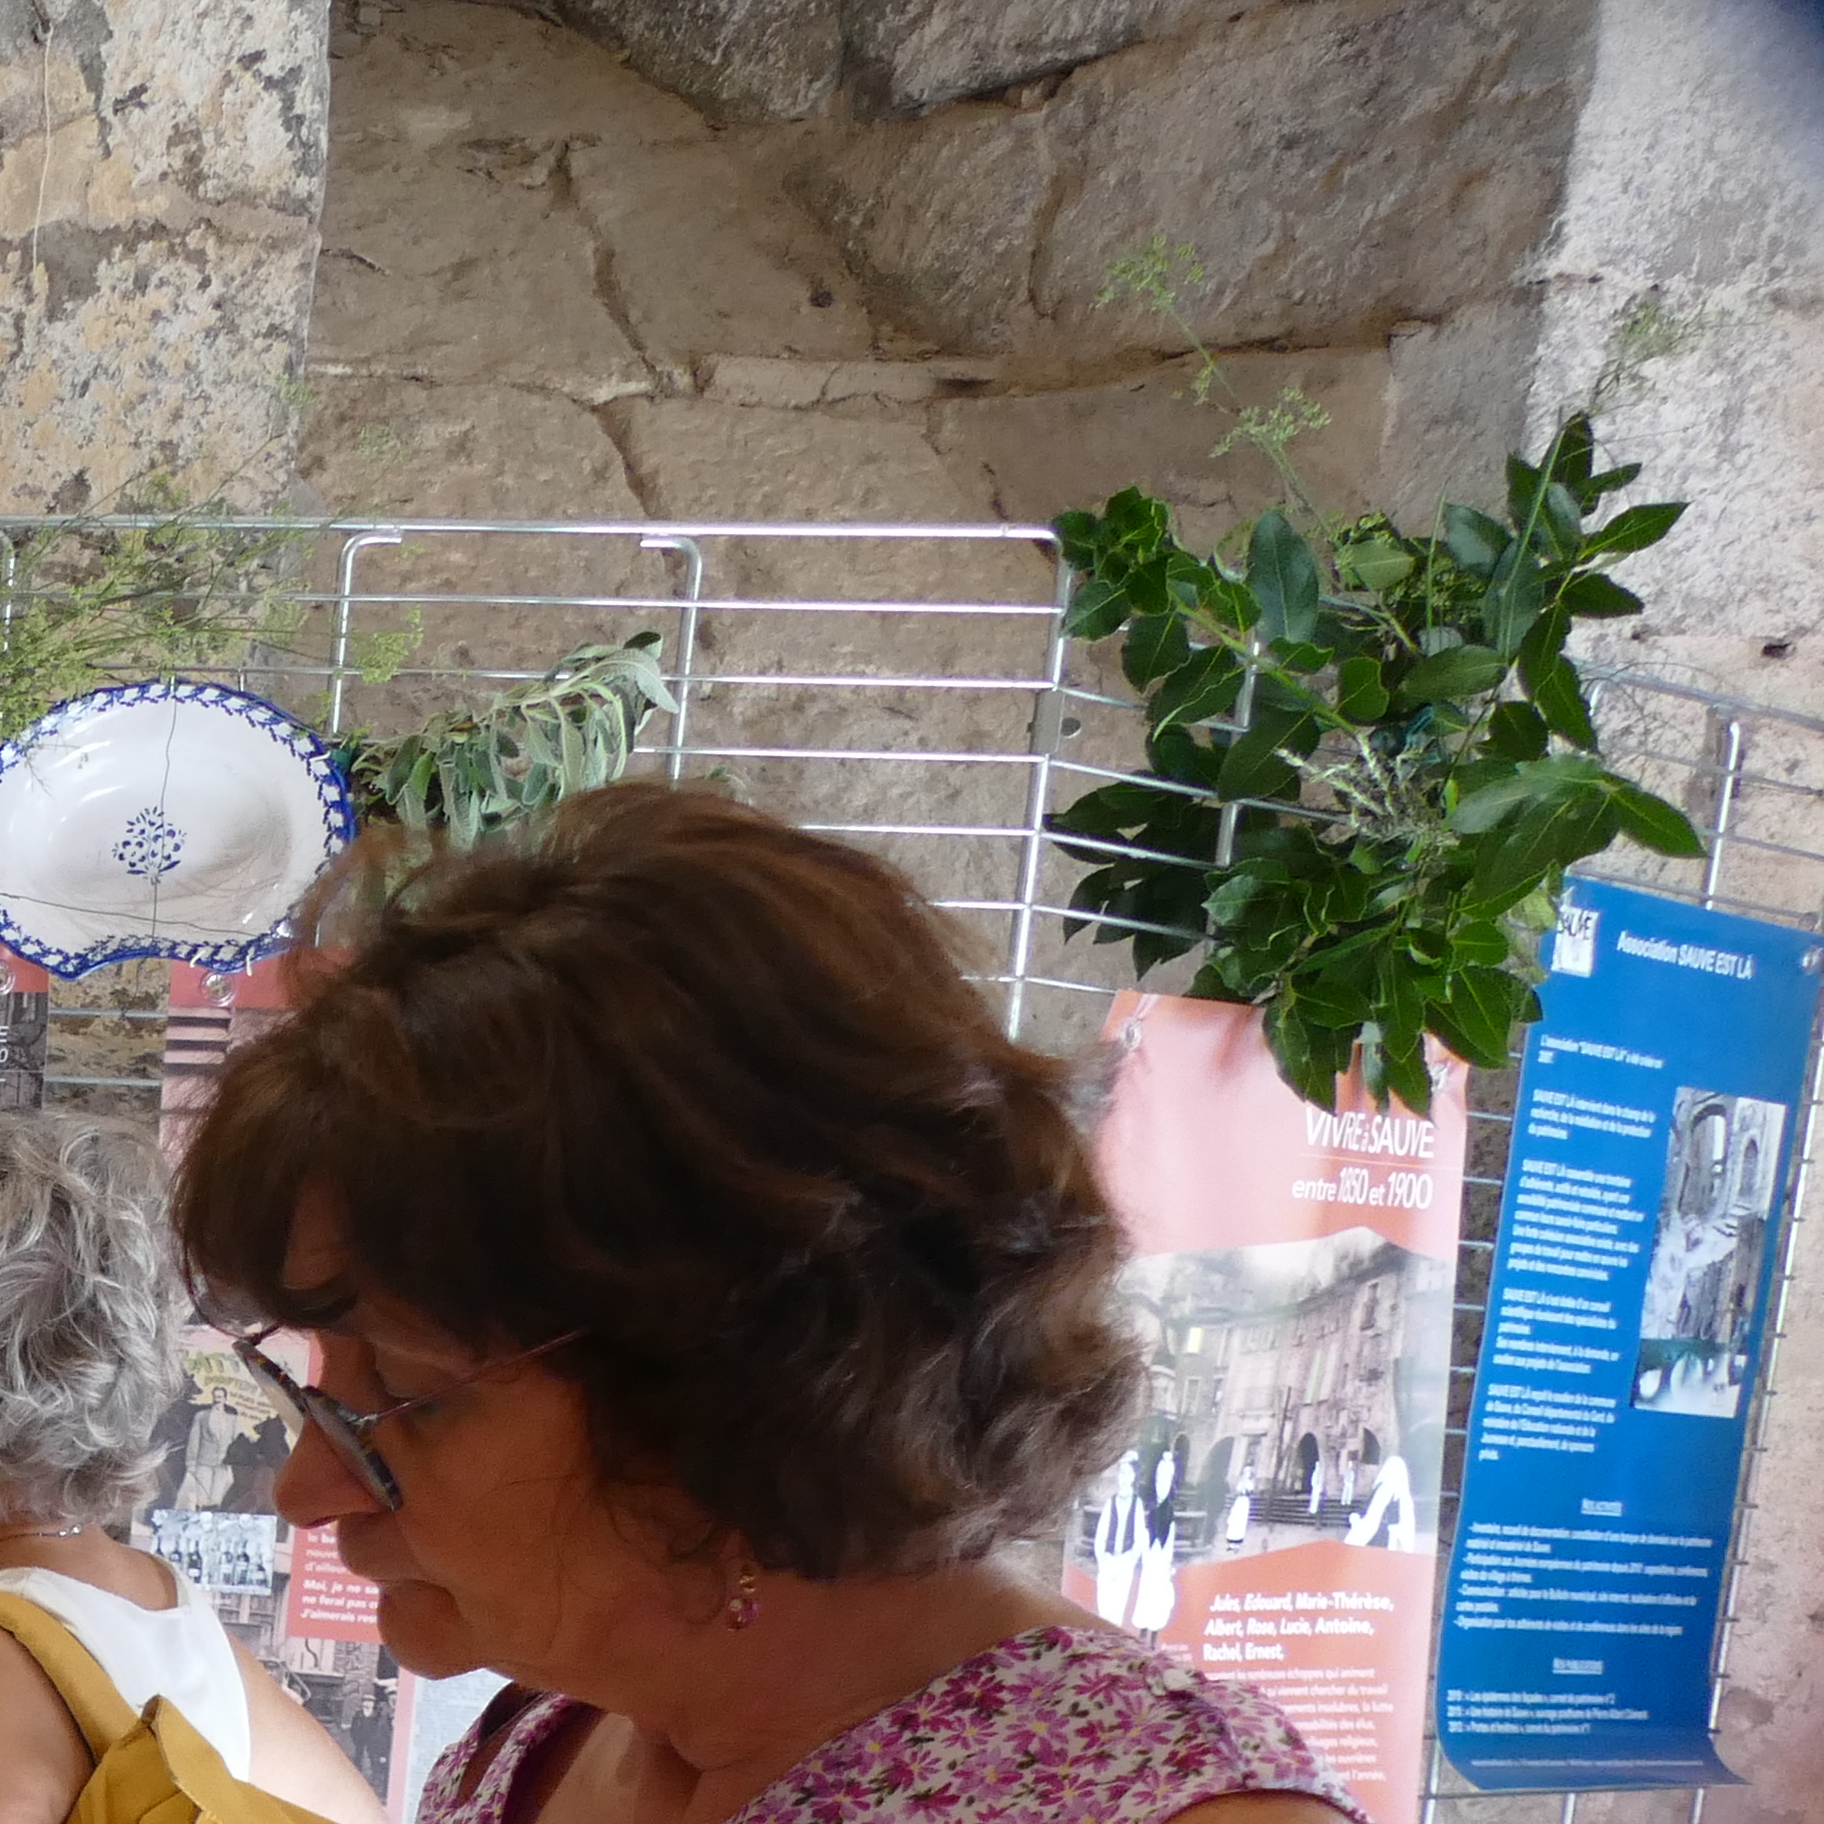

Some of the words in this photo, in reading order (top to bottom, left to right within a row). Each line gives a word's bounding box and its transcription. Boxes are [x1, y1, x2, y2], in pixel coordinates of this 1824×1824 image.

[1617, 930, 1678, 964] Association
[1677, 944, 1715, 973] SAUVE
[1715, 952, 1737, 976] EST
[1737, 953, 1754, 980] LÀ
[1306, 1107, 1366, 1150] VIVRE
[1368, 1115, 1435, 1158] SAUVE
[1292, 1179, 1337, 1201] entre
[1338, 1167, 1369, 1204] 1850
[1369, 1184, 1385, 1206] et
[1388, 1171, 1433, 1209] 1900
[331, 1582, 343, 1595] je
[347, 1584, 360, 1594] ne
[302, 1595, 316, 1604] ne
[319, 1594, 344, 1607] ferai
[347, 1598, 366, 1610] pas
[1210, 1594, 1242, 1612] Jules,
[1295, 1592, 1394, 1612] Marie-Thérèse,
[1205, 1618, 1244, 1637] Albert,
[1247, 1618, 1277, 1636] Rose,
[1280, 1618, 1312, 1636] Lucie,
[1315, 1616, 1374, 1636] Antoine,
[1203, 1643, 1242, 1662] Rachel,
[1245, 1643, 1284, 1661] Ernest,
